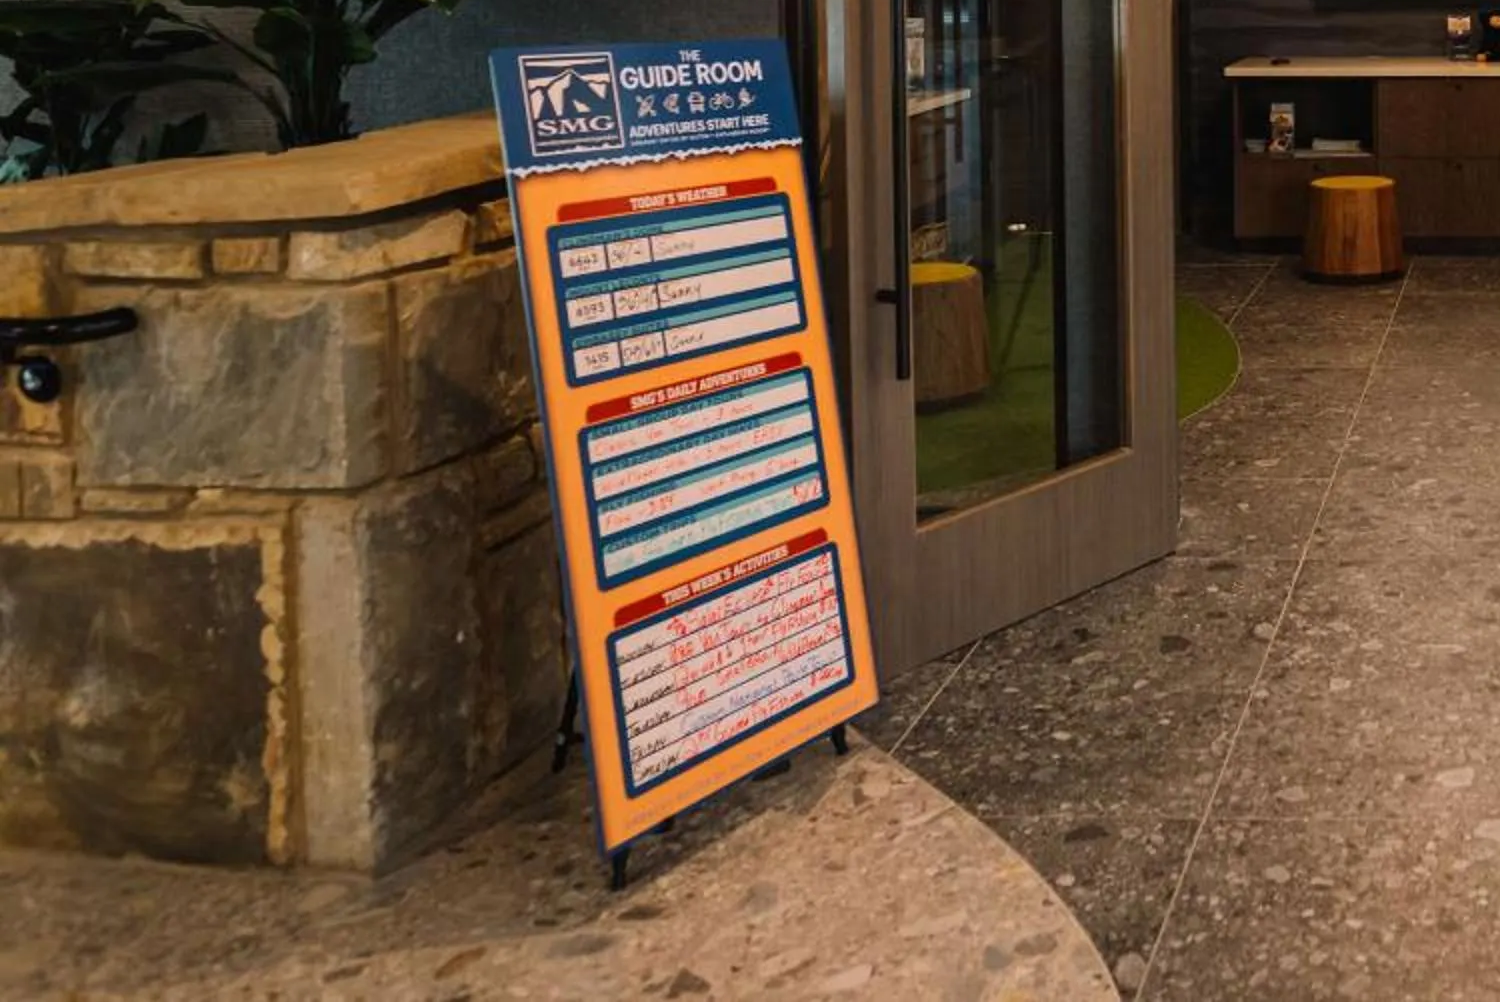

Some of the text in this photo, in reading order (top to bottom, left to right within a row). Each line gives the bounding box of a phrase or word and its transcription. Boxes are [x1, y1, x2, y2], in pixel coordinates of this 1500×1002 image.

[678, 50, 701, 62] THE
[620, 60, 763, 89] GUIDE ROOM
[537, 115, 615, 136] SMG
[629, 113, 769, 139] ADVENTURES START HERE
[667, 382, 699, 401] DAILY
